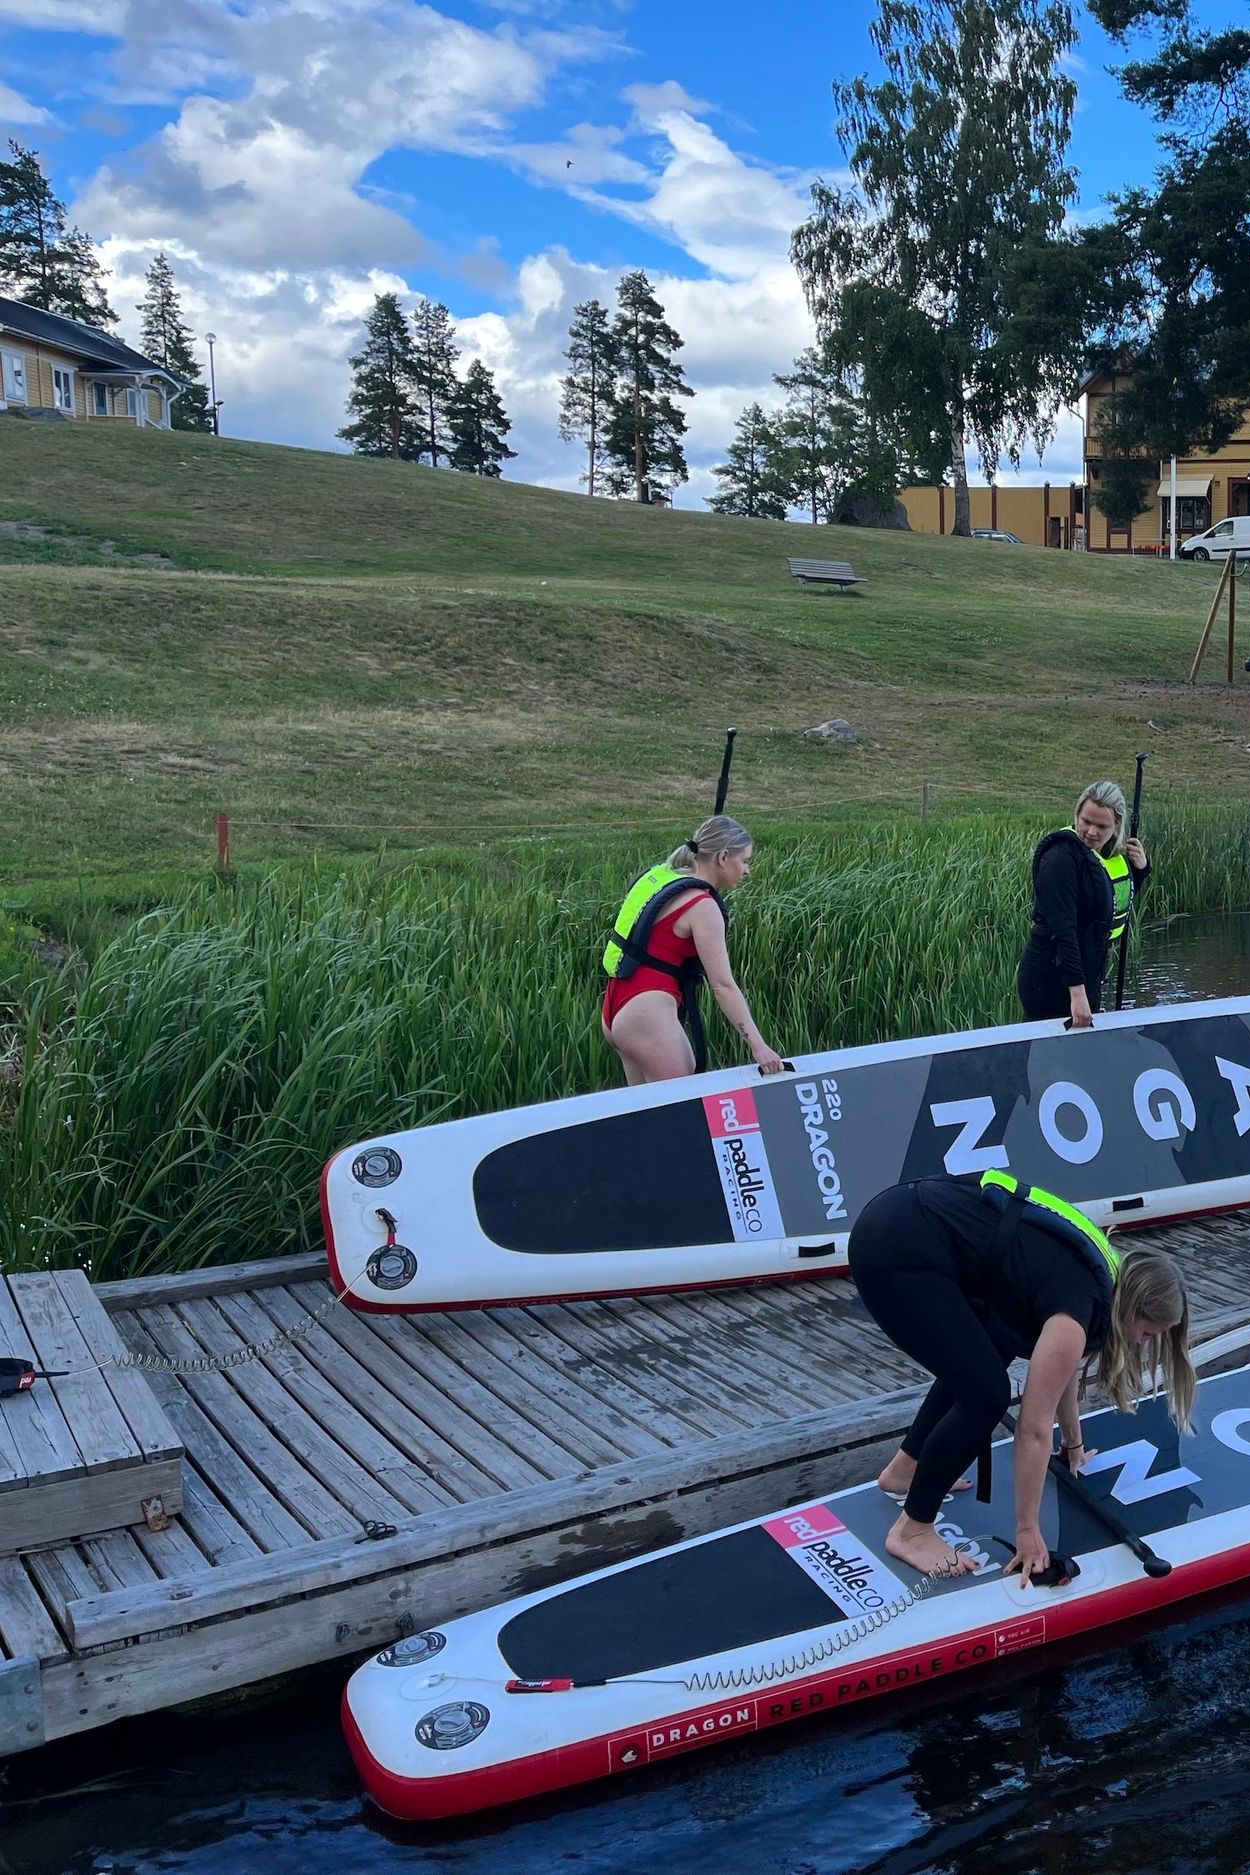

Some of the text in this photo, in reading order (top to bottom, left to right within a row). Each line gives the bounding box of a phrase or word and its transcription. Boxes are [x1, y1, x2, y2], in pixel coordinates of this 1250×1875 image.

[821, 1079, 842, 1121] 220
[795, 1082, 848, 1220] DRAGON
[722, 1154, 742, 1221] RACING
[804, 1555, 851, 1602] RACING
[769, 1691, 823, 1719] RED
[838, 1657, 944, 1701] PADDLE
[954, 1644, 988, 1666] CO
[652, 1708, 750, 1747] DRAGON
